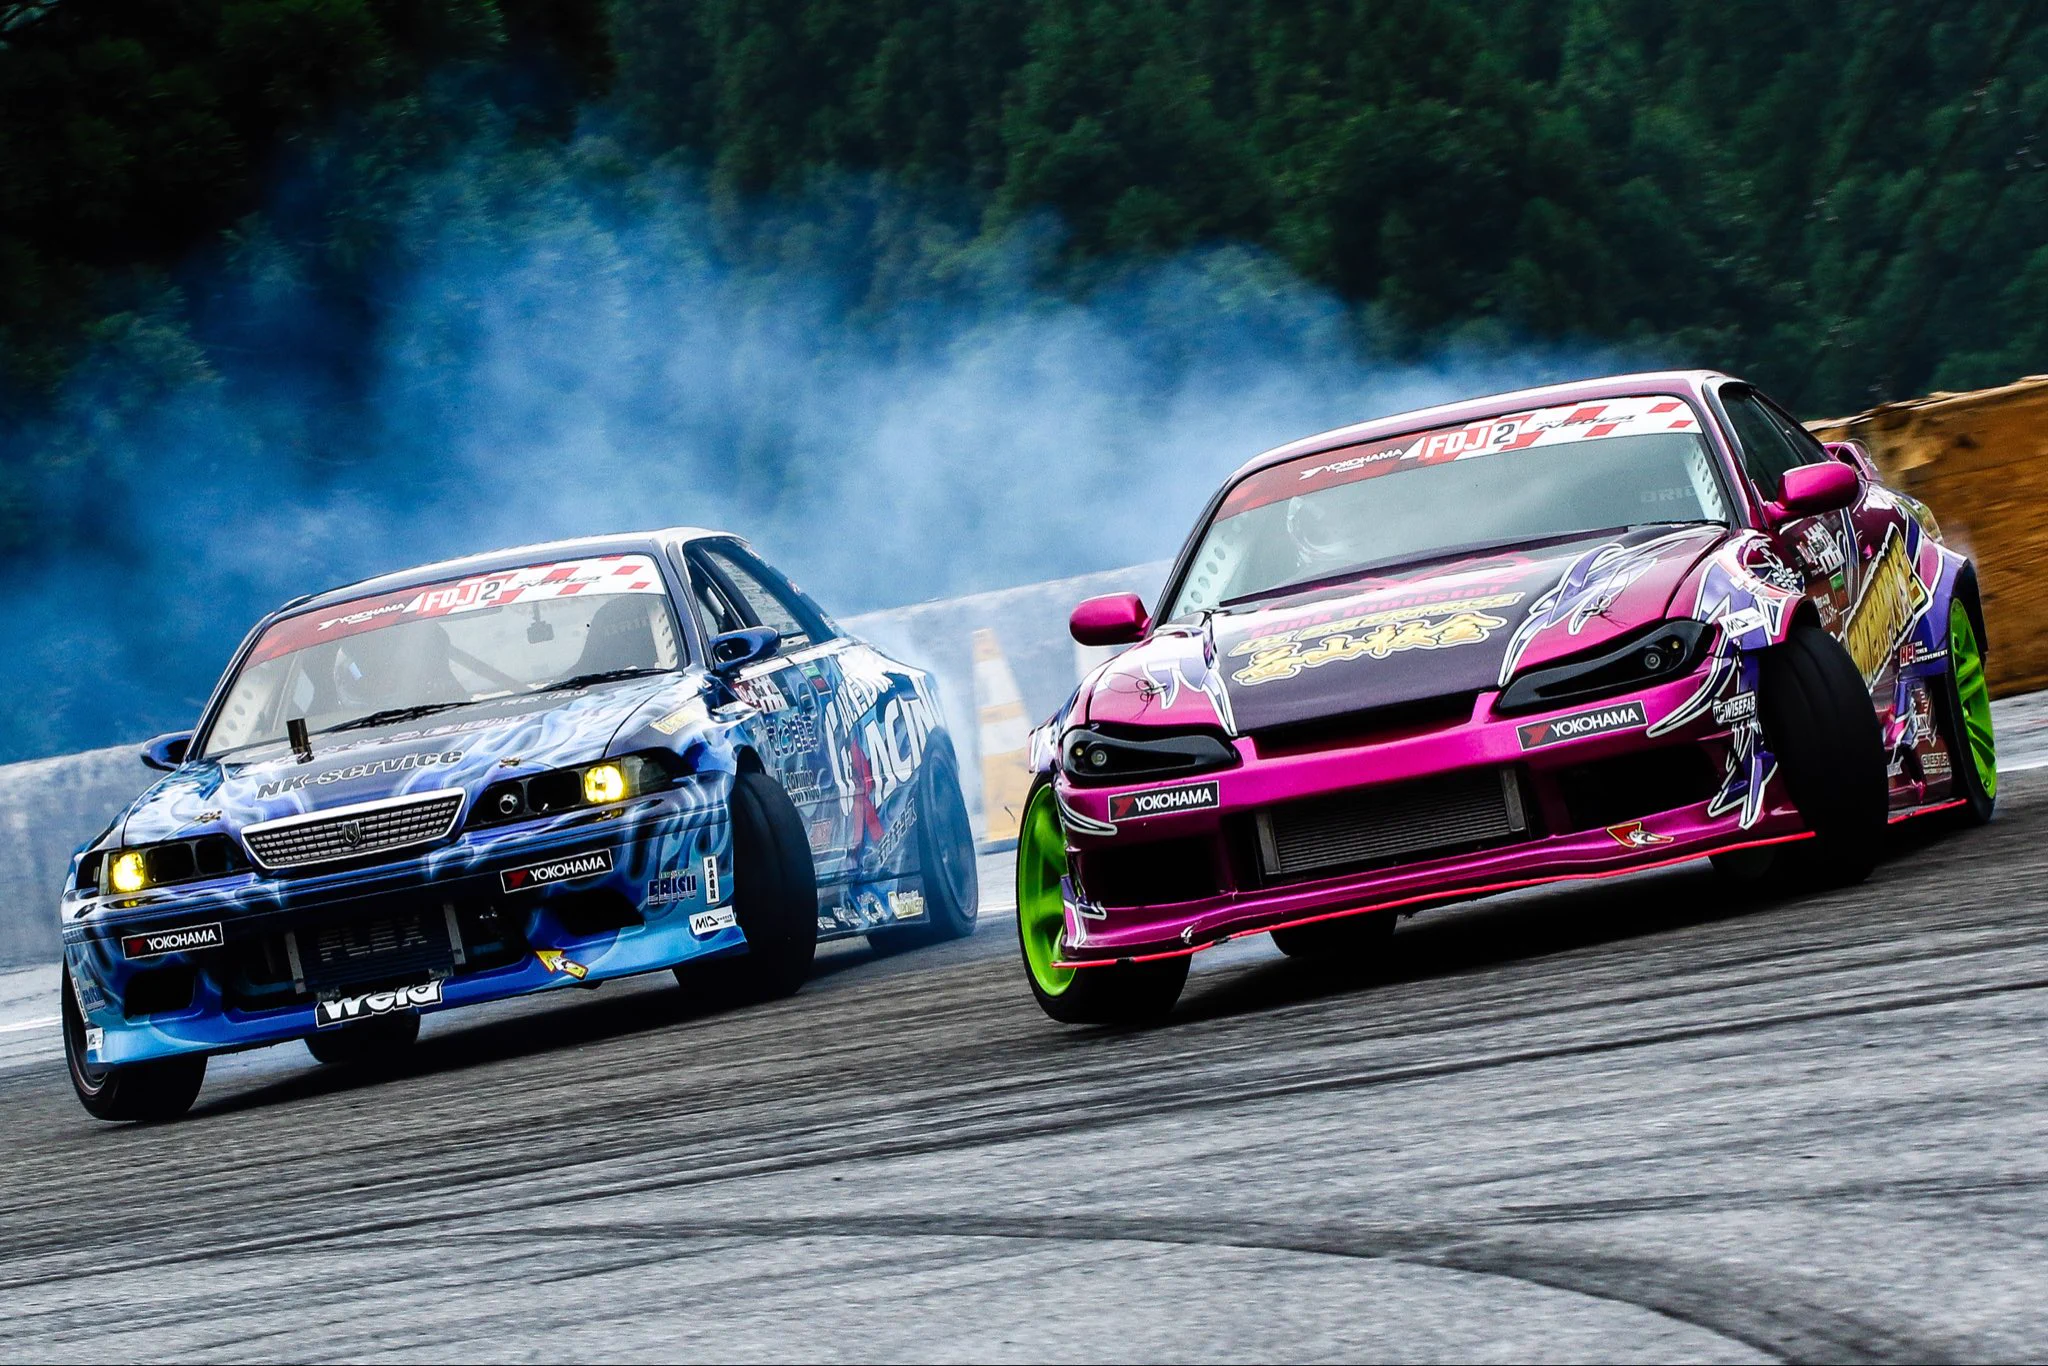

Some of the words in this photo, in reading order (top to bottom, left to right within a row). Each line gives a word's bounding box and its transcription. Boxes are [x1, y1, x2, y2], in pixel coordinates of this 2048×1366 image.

[1324, 449, 1403, 472] YOKOHAMA
[339, 603, 405, 623] YOKOHAMA
[1551, 706, 1640, 738] YOKOHAMA
[1135, 788, 1213, 812] YOKOHAMA
[530, 856, 606, 882] YOKOHAMA
[147, 930, 217, 952] YOKOHAMA
